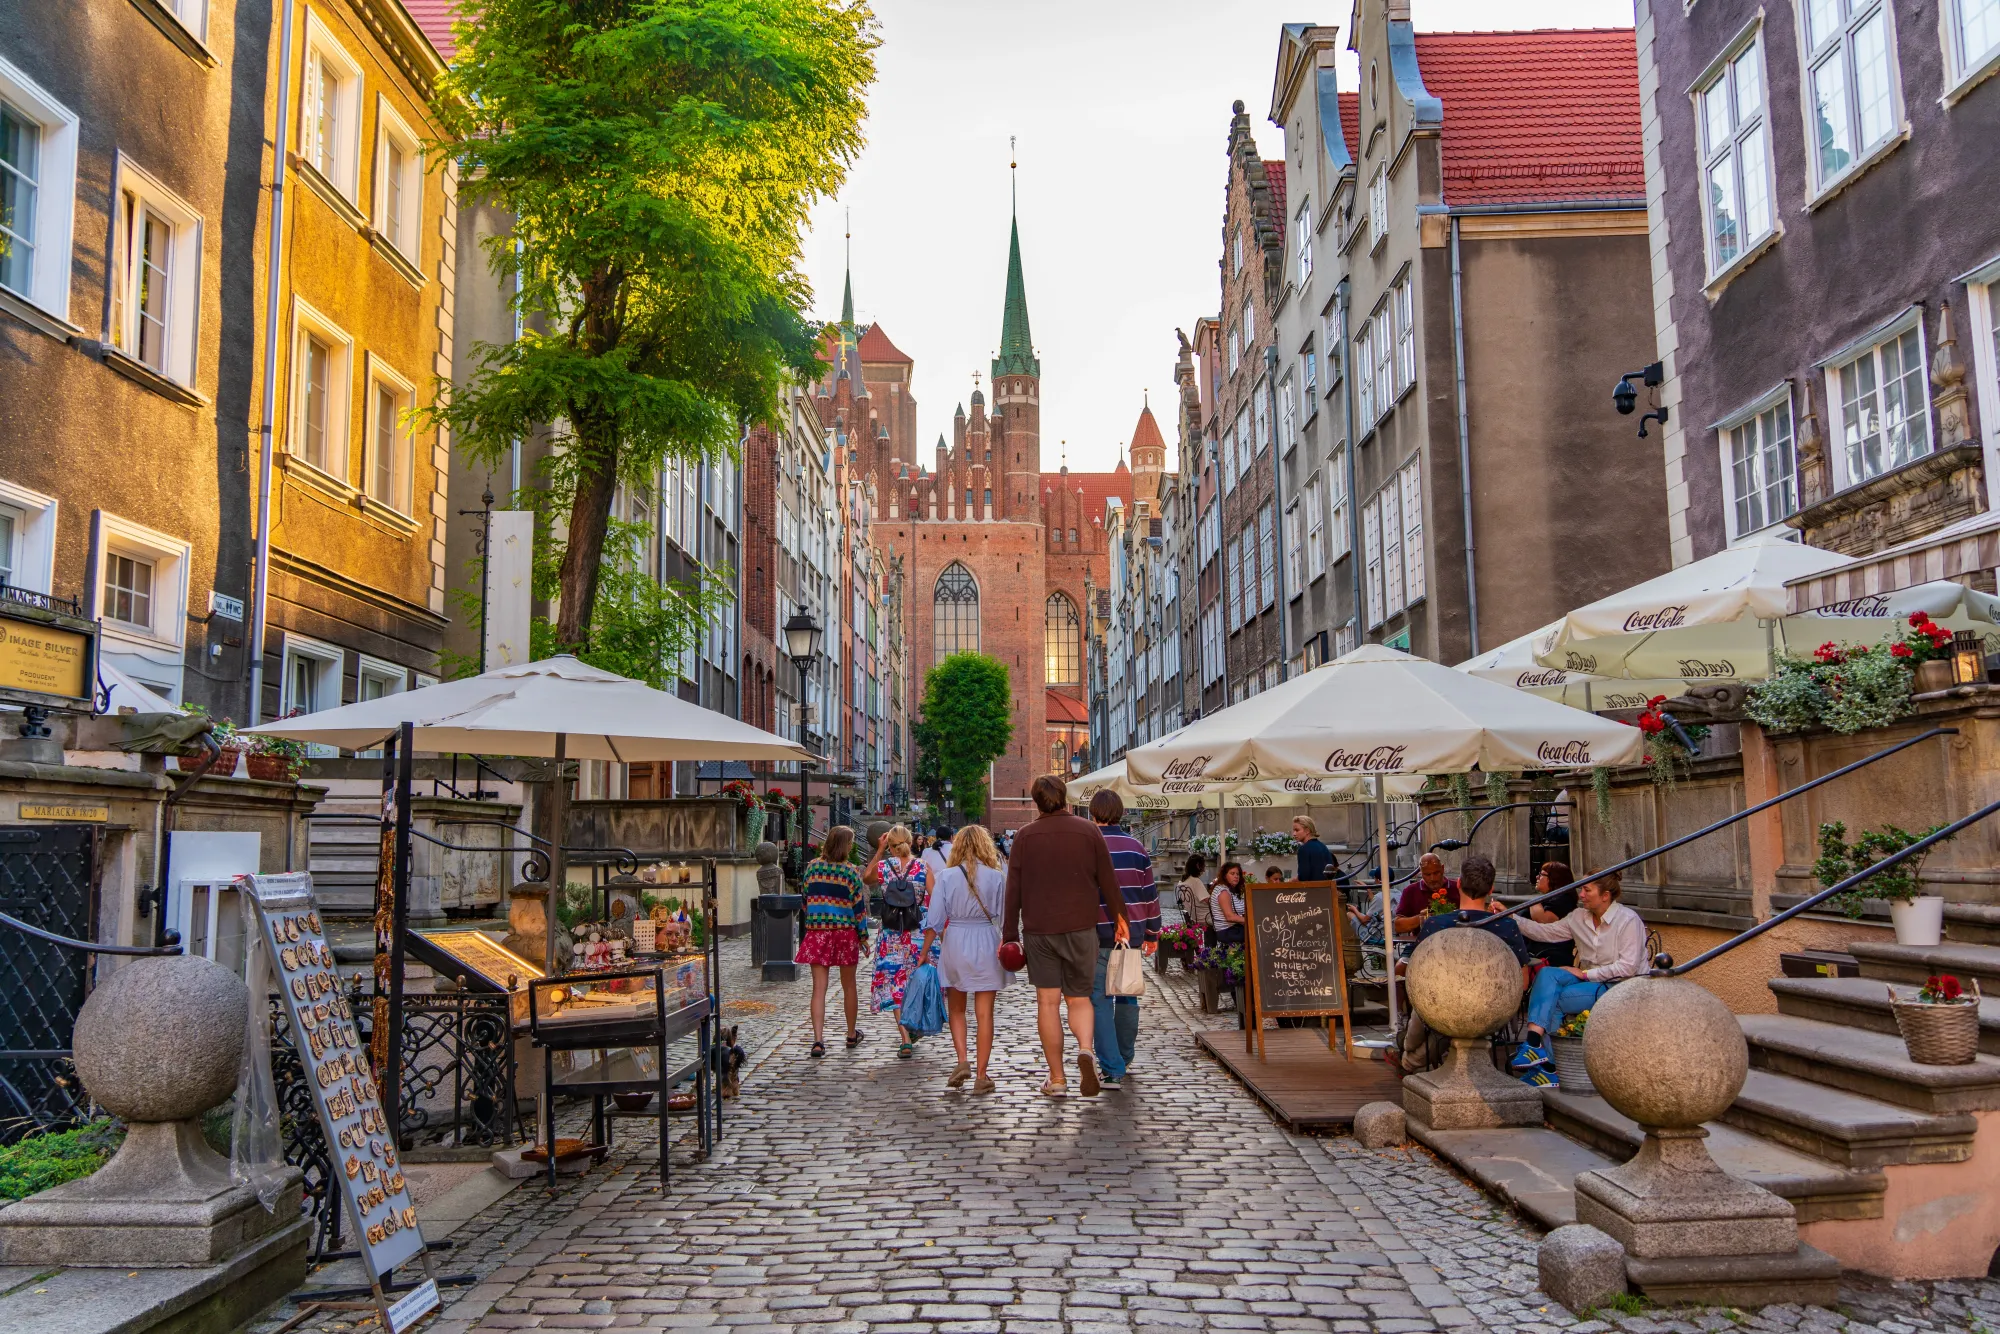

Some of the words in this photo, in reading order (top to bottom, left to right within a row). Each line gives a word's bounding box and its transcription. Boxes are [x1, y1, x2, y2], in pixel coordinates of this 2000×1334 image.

[5, 587, 37, 607] IMAGE
[1623, 605, 1689, 632] Coca-Cola
[9, 635, 41, 649] IMAGE
[45, 642, 79, 656] SILVER
[20, 669, 55, 681] PRODUCENT
[1516, 669, 1567, 688] Coca-Cola
[1325, 744, 1408, 773] Coca-Cola
[1537, 740, 1593, 764] Coca-Cola
[1285, 778, 1324, 792] Coca-Cola
[33, 806, 77, 817] MARIACKA
[79, 807, 97, 817] 18/20
[1276, 892, 1307, 904] Coca-Cola
[1262, 915, 1286, 940] Café
[1303, 986, 1333, 996] LIBRE
